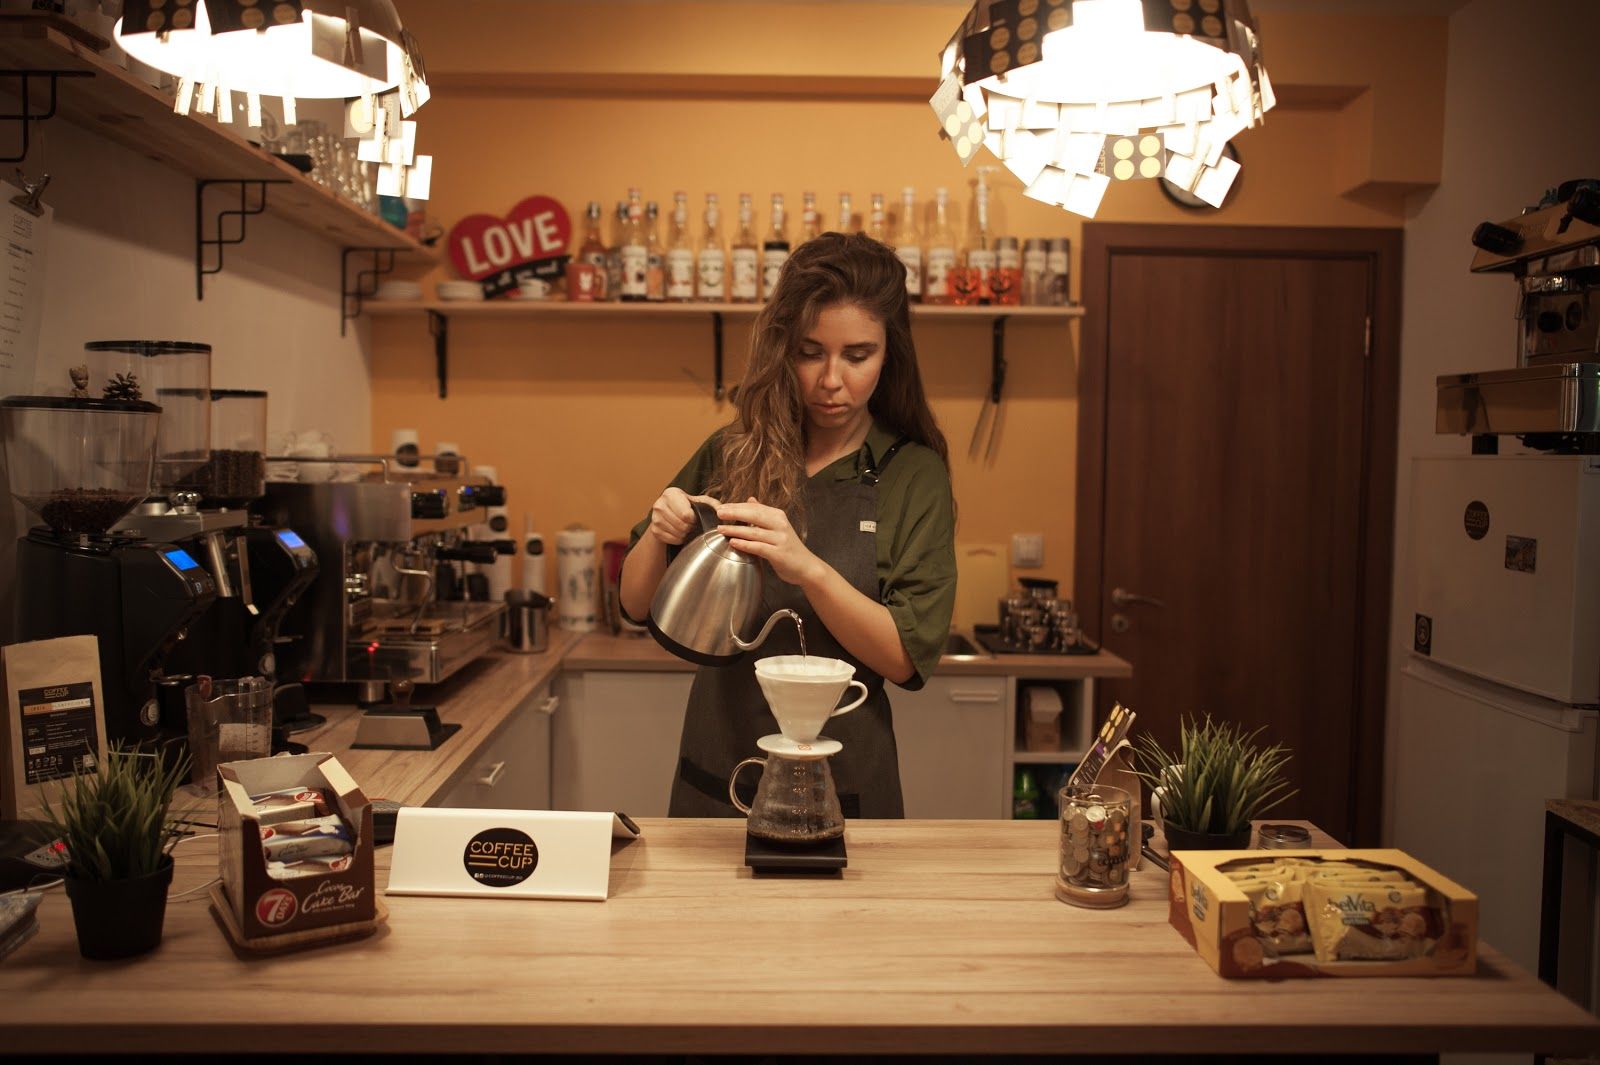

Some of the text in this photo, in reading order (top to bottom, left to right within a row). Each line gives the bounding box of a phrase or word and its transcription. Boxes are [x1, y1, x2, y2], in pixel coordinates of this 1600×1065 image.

[461, 210, 563, 274] LOVE
[470, 840, 534, 856] COFFEE
[498, 855, 533, 869] CUP
[263, 893, 288, 922] 7
[276, 896, 294, 921] DAYS
[301, 892, 335, 914] Cake
[338, 885, 365, 903] Bar
